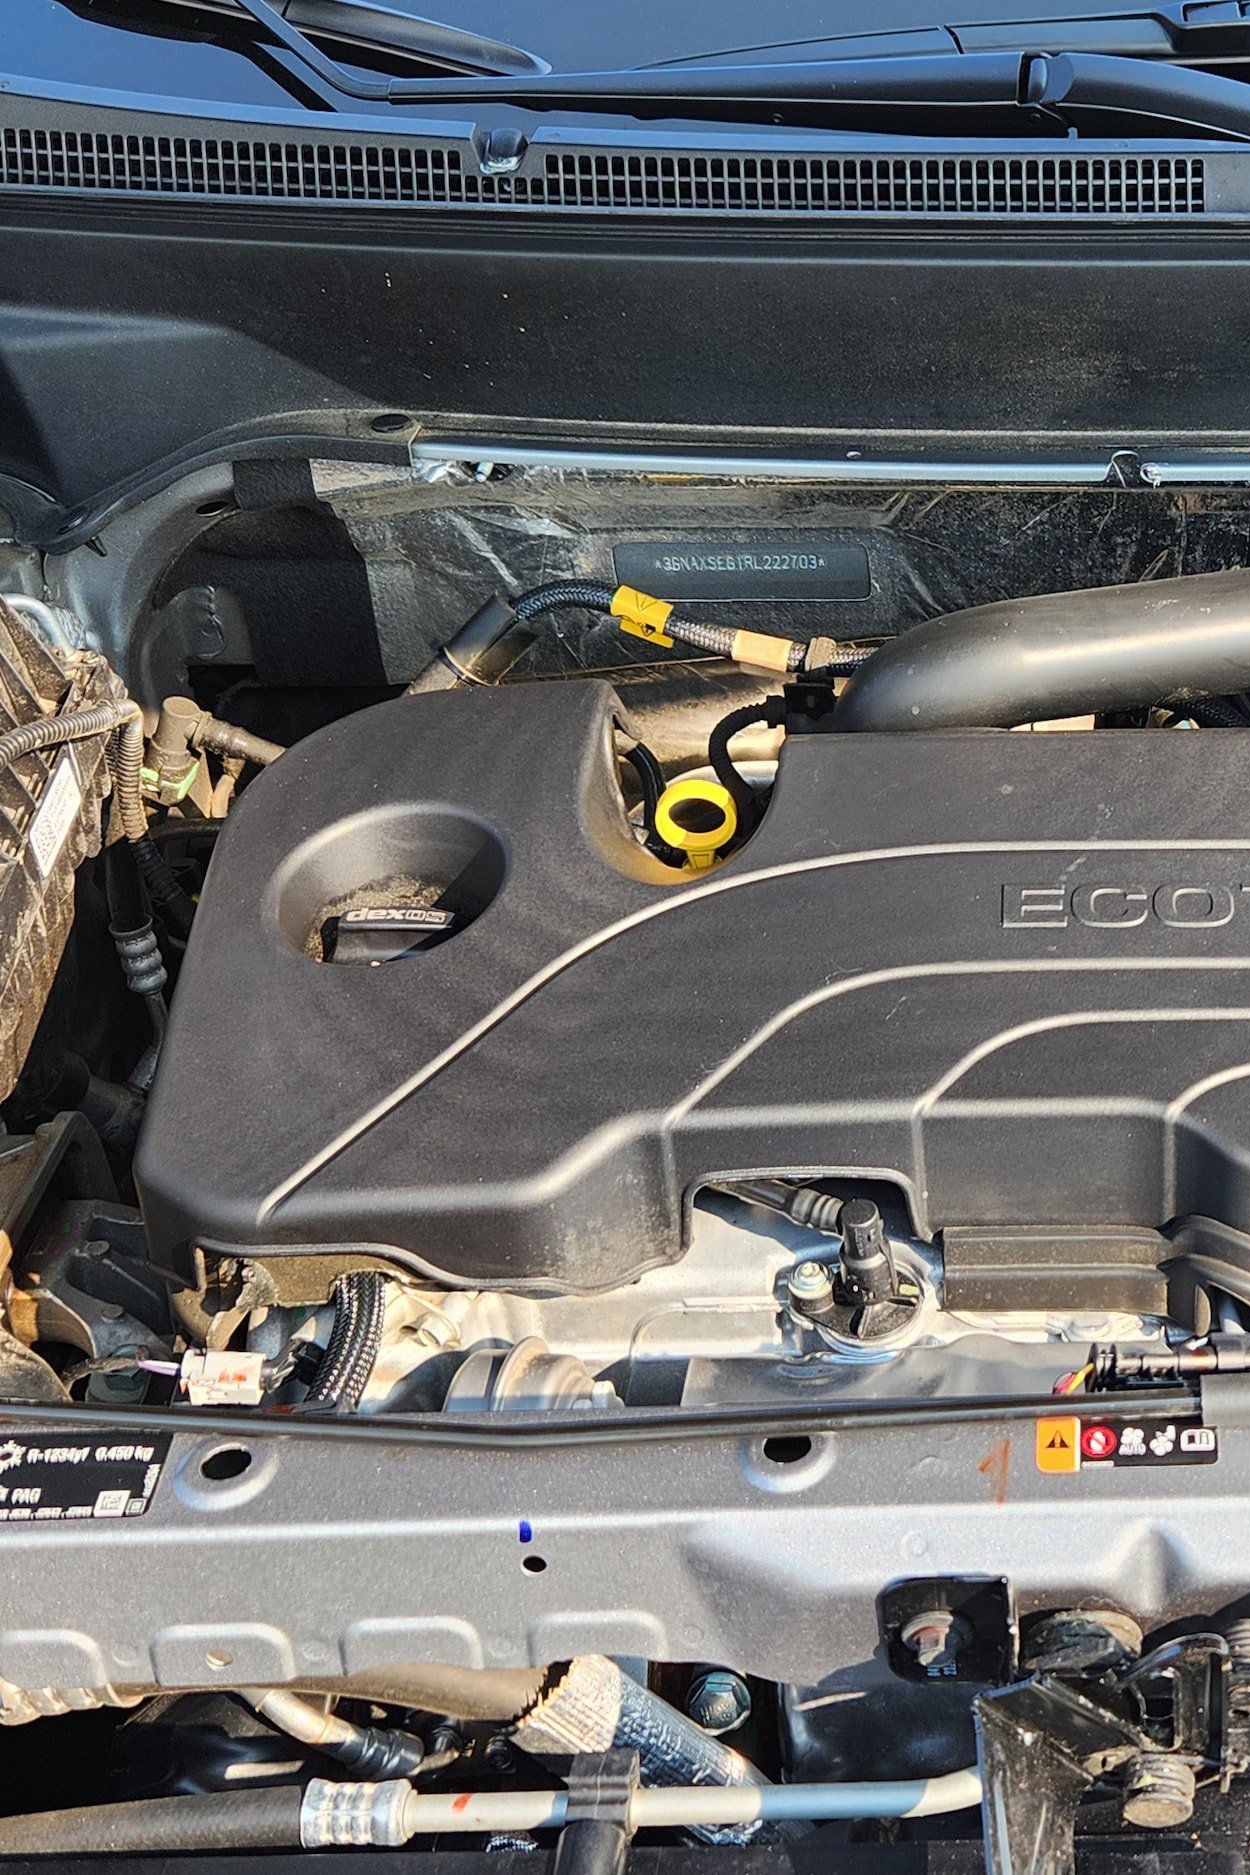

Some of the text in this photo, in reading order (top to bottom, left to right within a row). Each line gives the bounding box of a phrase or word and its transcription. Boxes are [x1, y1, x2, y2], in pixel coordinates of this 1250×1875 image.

[346, 908, 447, 923] dexos
[134, 1445, 155, 1463] kg
[1118, 1444, 1147, 1456] AUTO
[11, 1488, 42, 1504] PAG
